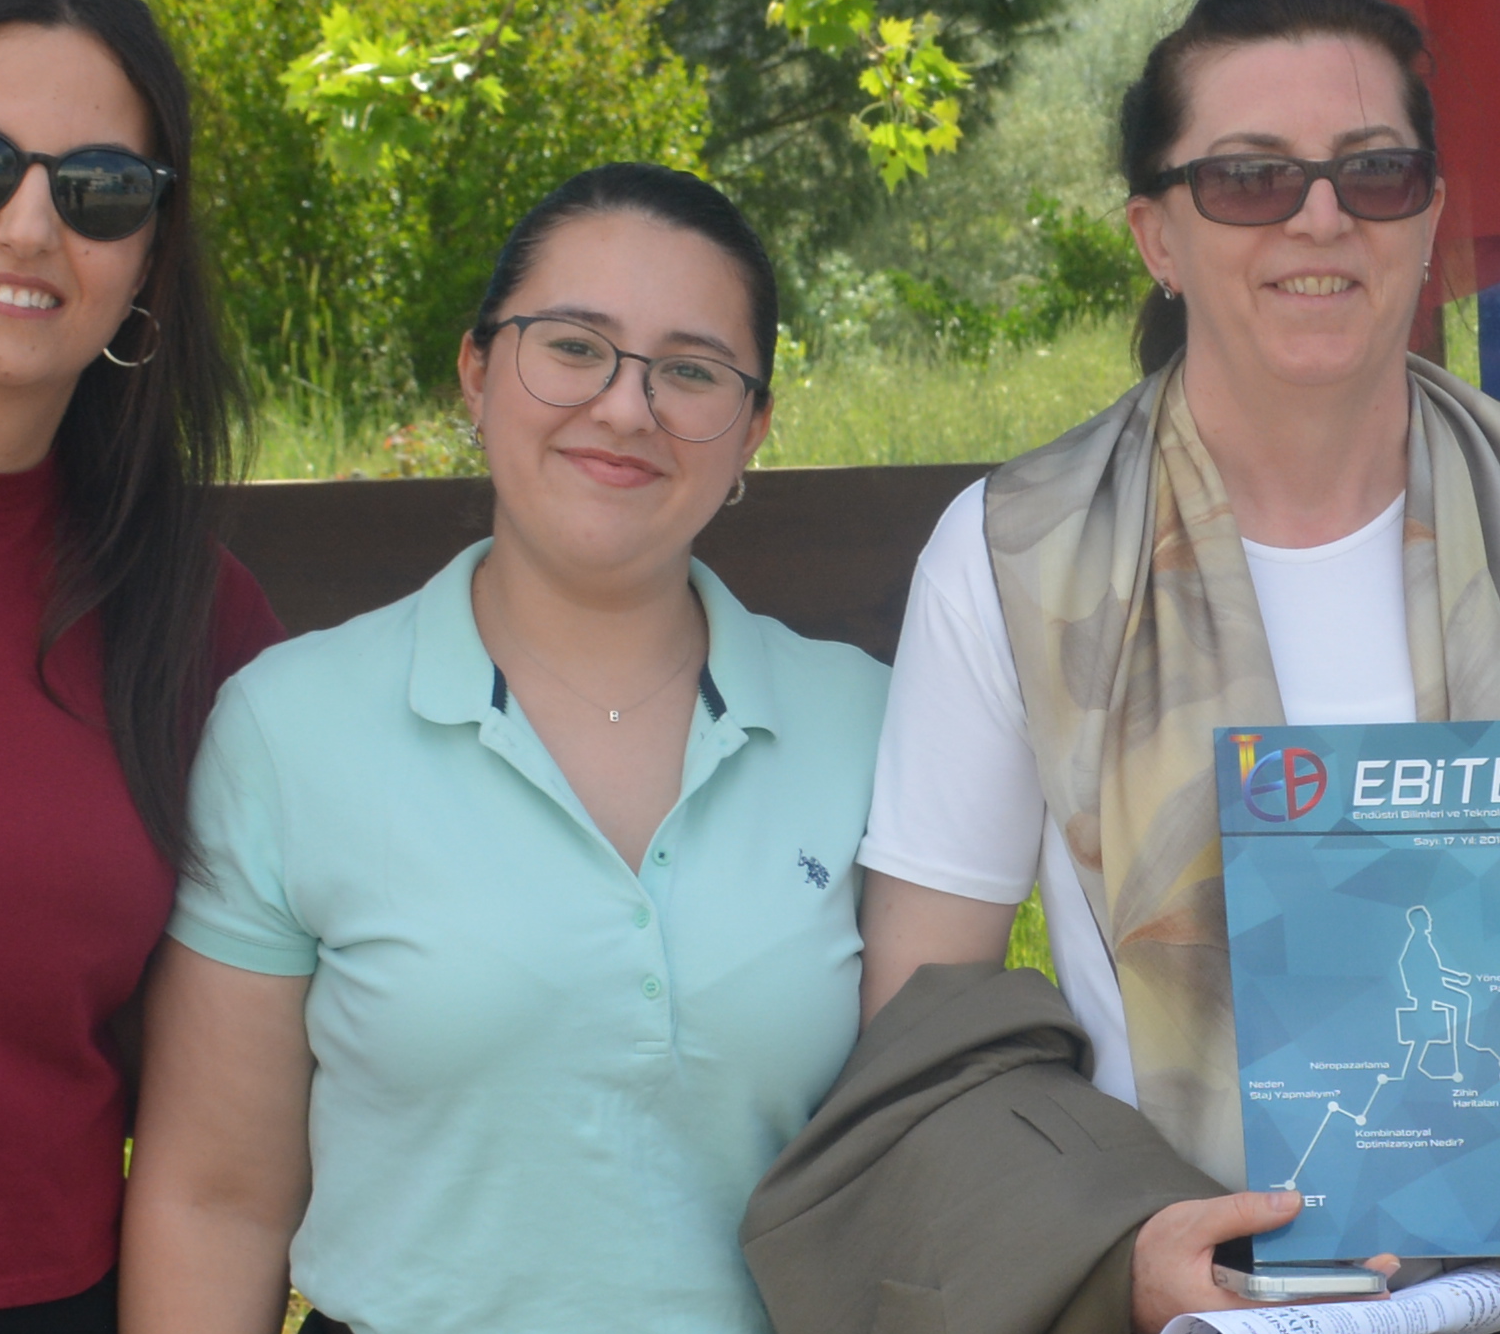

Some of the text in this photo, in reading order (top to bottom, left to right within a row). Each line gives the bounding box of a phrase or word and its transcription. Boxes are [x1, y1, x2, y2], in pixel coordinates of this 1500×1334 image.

[1353, 810, 1399, 820] Endüstri
[1401, 808, 1445, 819] Bilimleri
[1446, 810, 1461, 818] ve
[1443, 836, 1455, 845] 17
[1310, 1060, 1390, 1072] Nöropazarlama
[1249, 1080, 1285, 1089] Neden
[1249, 1090, 1273, 1102] Staj
[1452, 1088, 1479, 1098] Zihin
[1355, 1127, 1432, 1140] Kombinatoryal
[1356, 1137, 1465, 1150] Optimizasyon Nedir?
